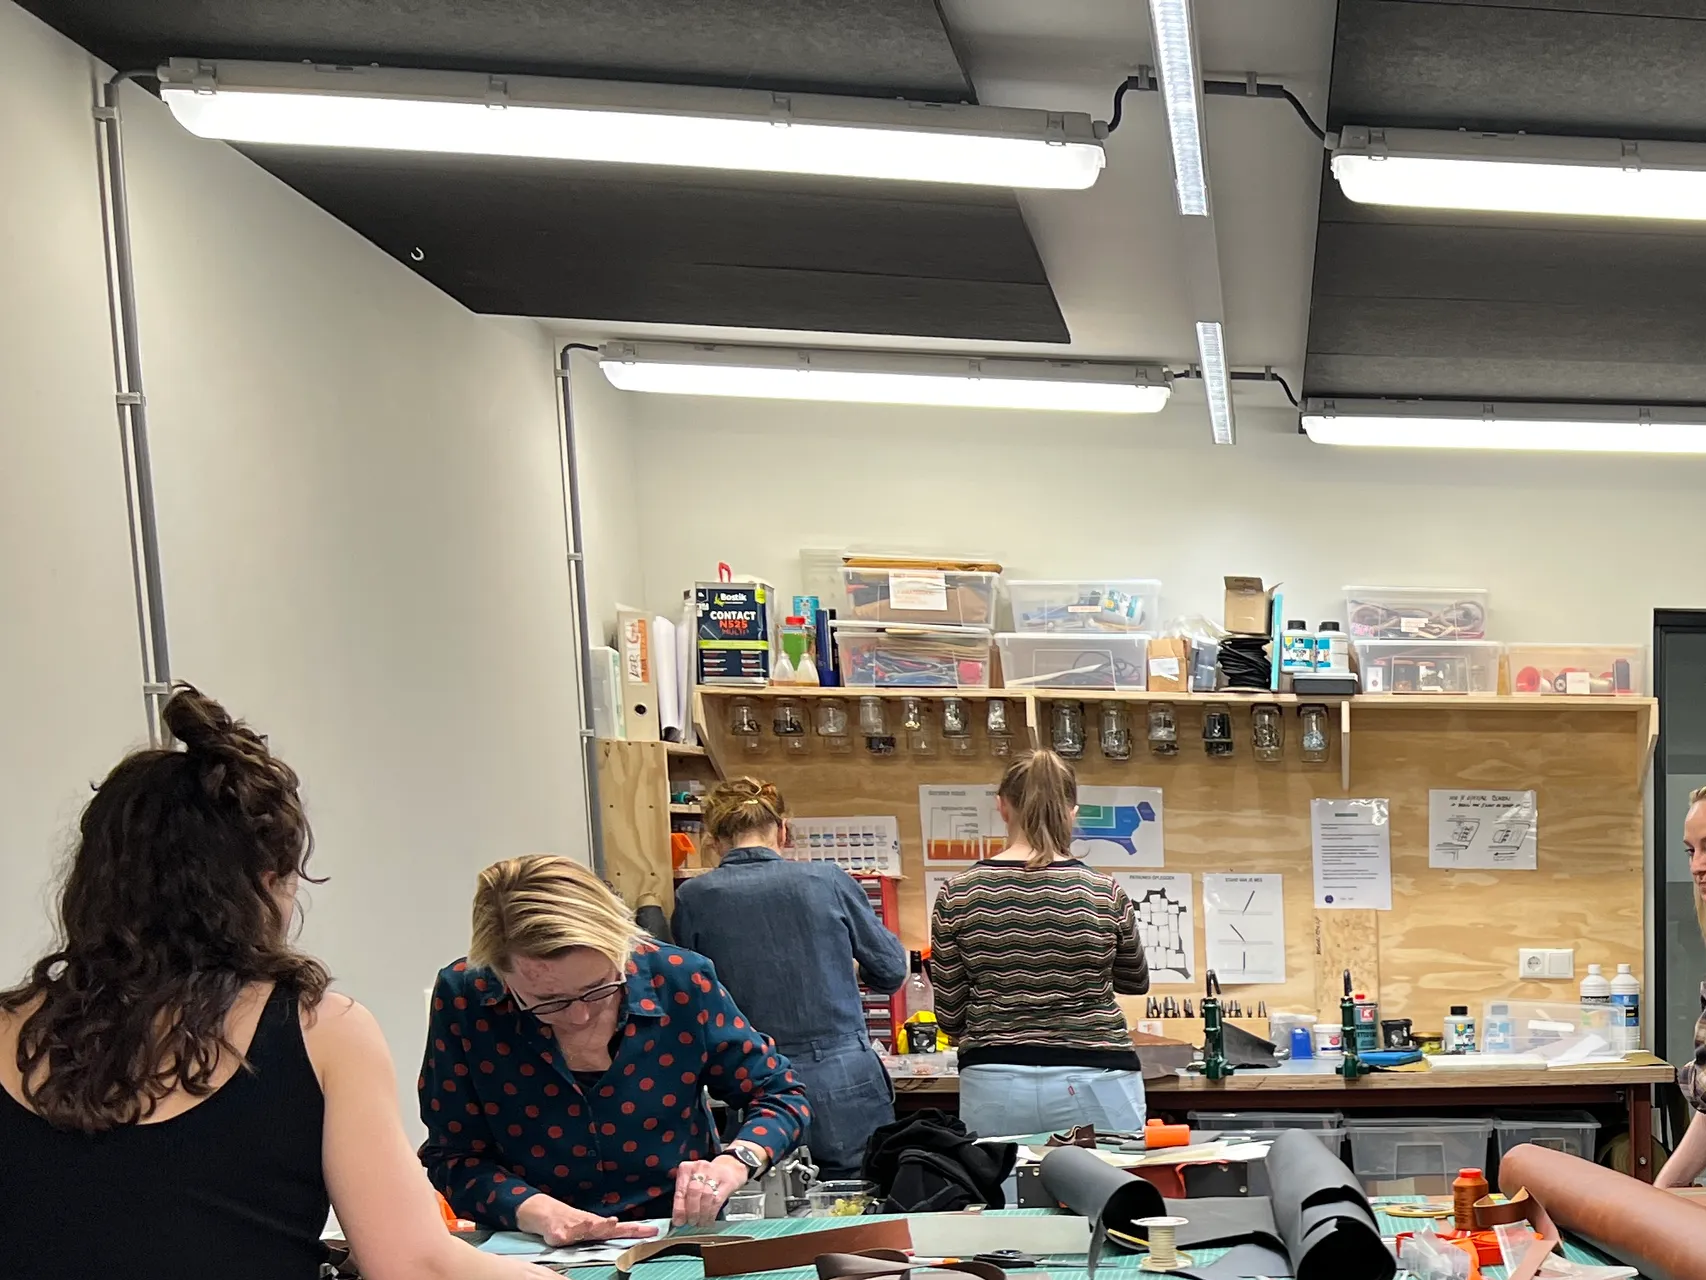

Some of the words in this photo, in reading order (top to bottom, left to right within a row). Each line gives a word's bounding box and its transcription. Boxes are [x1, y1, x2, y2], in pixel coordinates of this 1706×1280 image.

[720, 592, 748, 602] Bostik
[709, 611, 757, 621] CONTACT
[719, 620, 748, 629] N525
